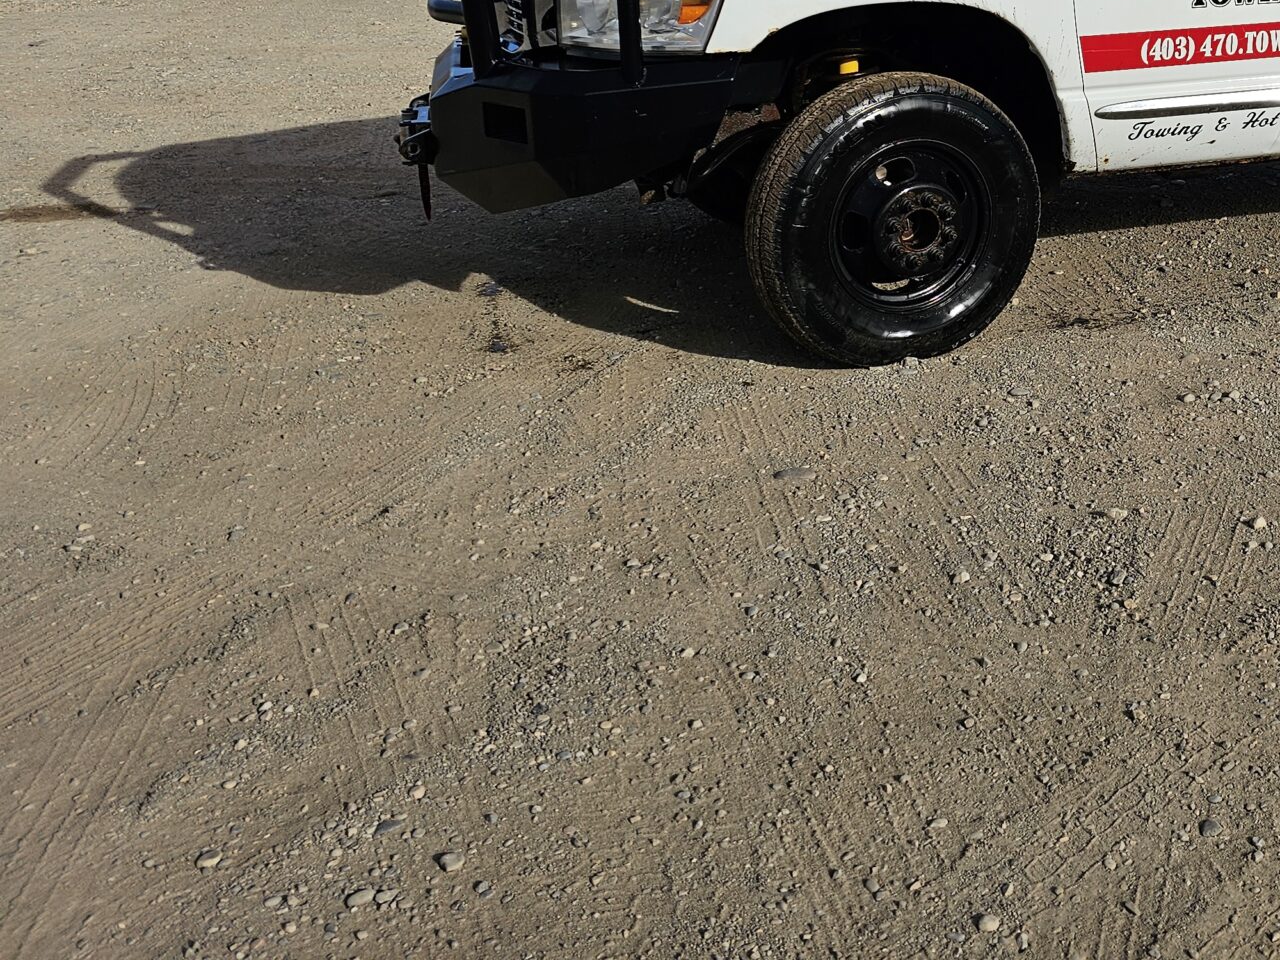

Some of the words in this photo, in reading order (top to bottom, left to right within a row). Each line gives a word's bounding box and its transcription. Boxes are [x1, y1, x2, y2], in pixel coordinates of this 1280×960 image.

[1140, 35, 1195, 64] (403)
[1128, 121, 1203, 141] Towing
[1215, 117, 1231, 131] &
